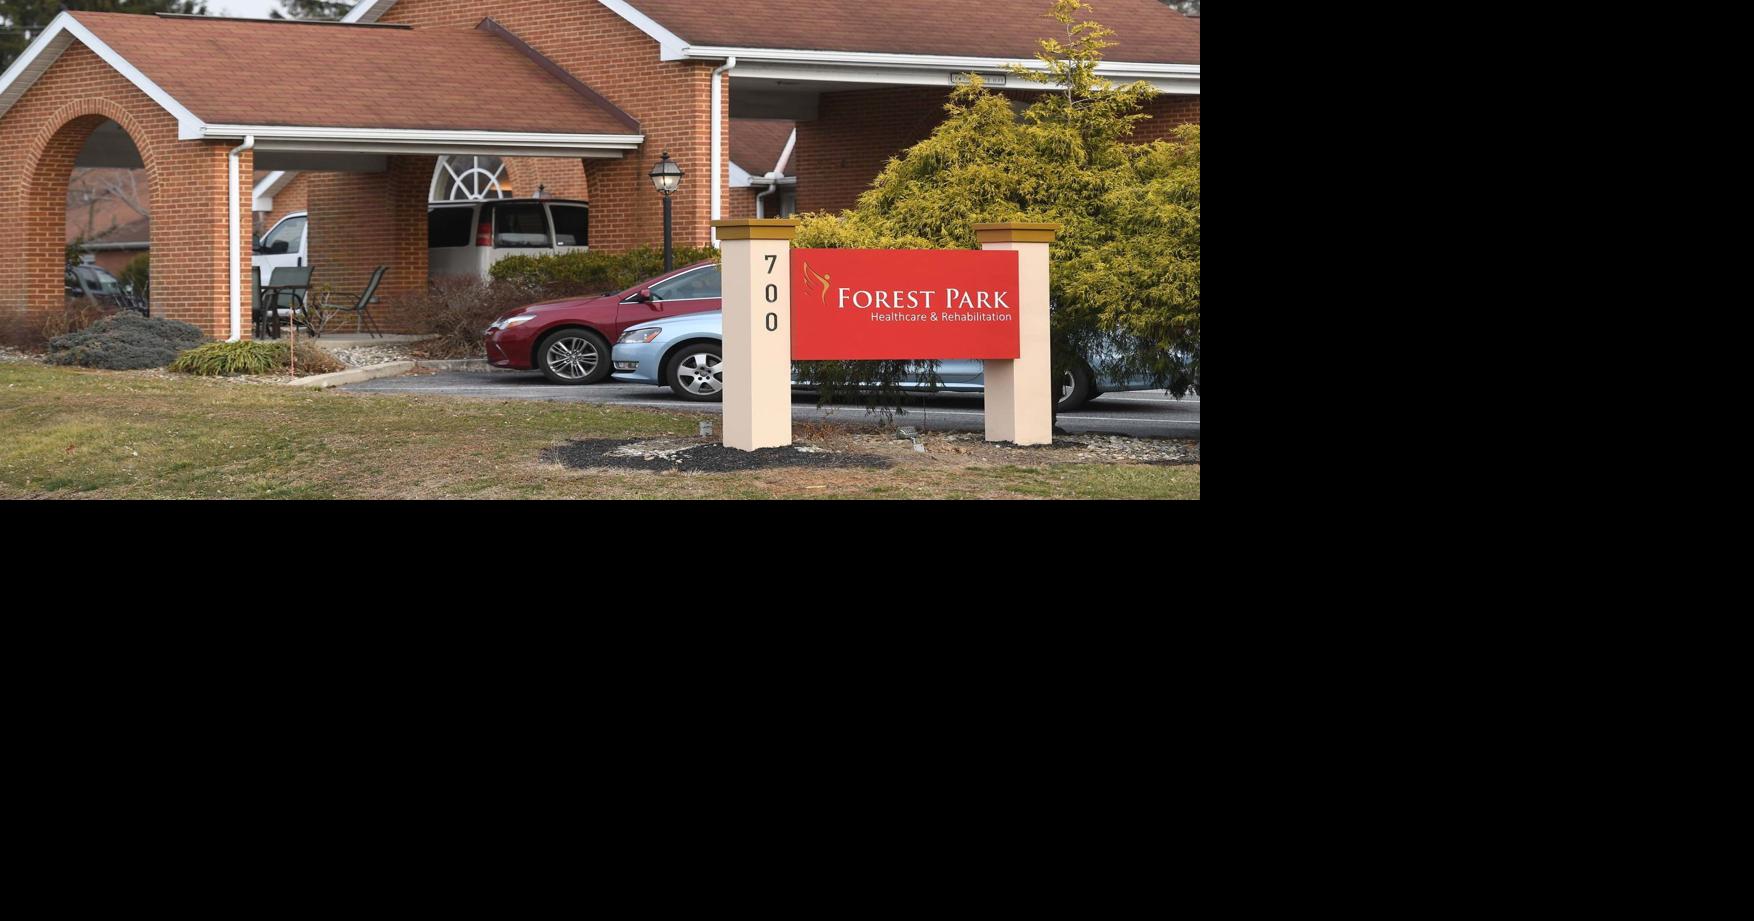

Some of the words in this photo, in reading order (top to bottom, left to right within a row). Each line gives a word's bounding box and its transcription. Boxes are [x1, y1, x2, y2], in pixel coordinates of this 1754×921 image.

[764, 254, 778, 332] 700
[838, 287, 936, 309] FOREST
[946, 287, 1010, 309] PARK
[871, 312, 927, 322] Healthcare
[930, 312, 938, 322] &
[941, 311, 1012, 322] Rehabilitation
